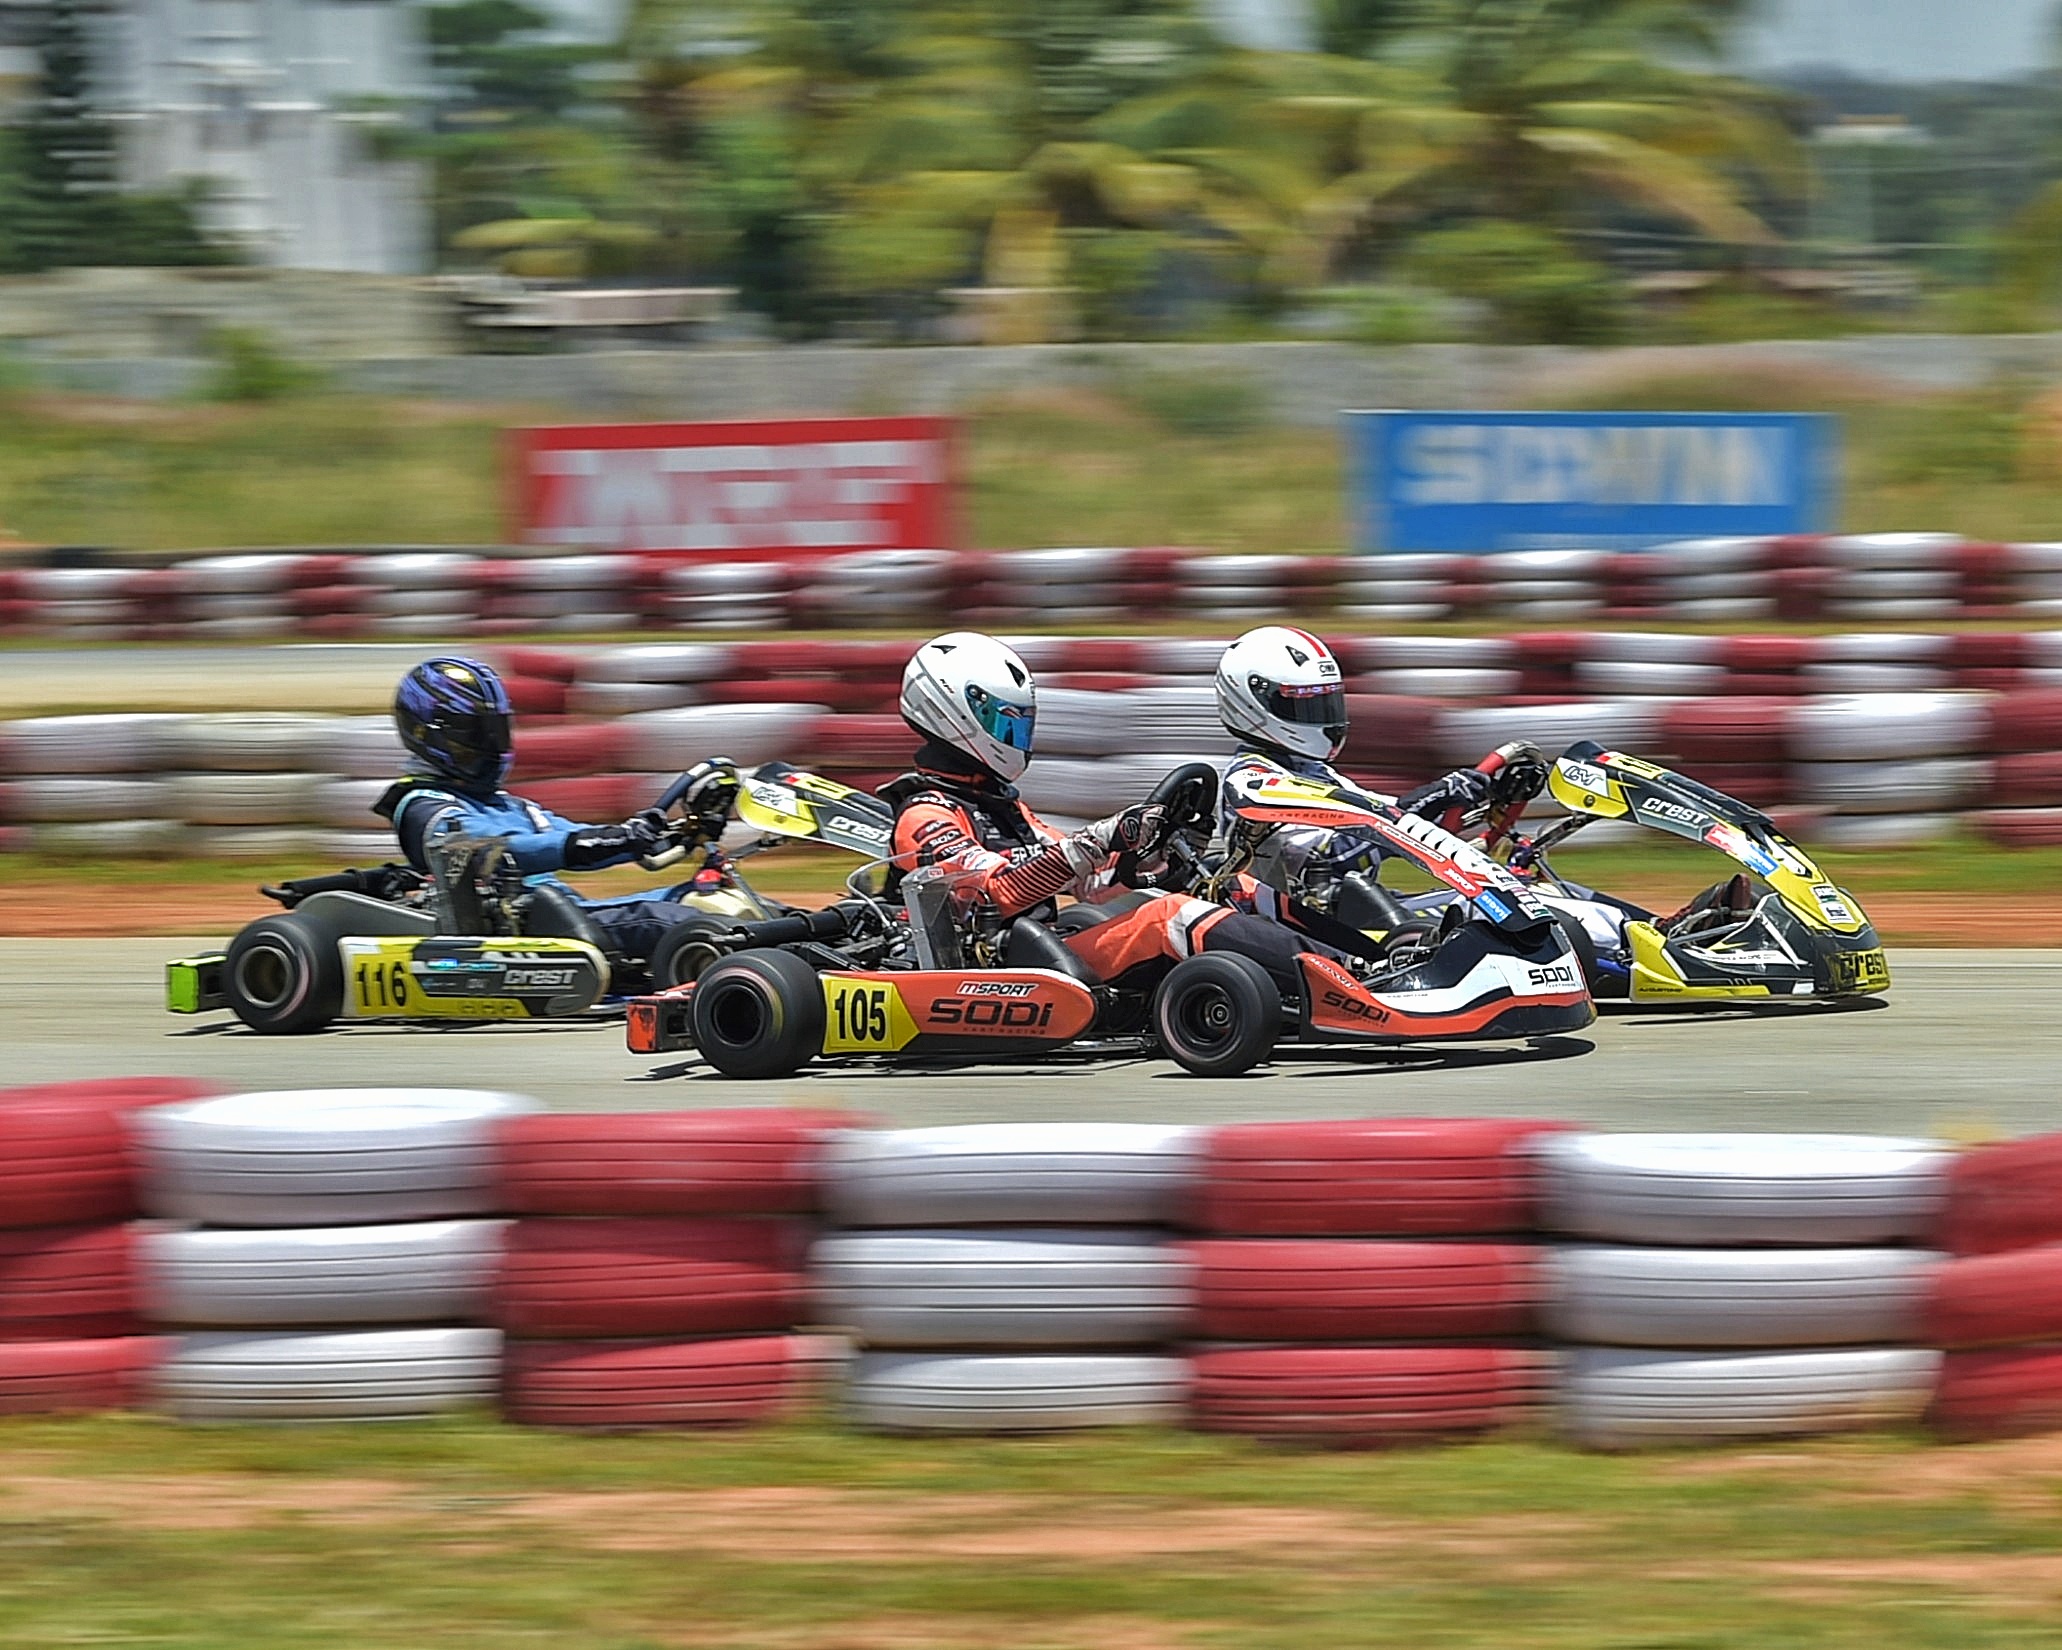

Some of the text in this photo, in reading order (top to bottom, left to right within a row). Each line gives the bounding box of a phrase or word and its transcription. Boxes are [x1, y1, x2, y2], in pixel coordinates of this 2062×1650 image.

[357, 965, 406, 1007] 116
[1528, 966, 1574, 986] SODI
[834, 988, 886, 1042] 105
[928, 998, 1054, 1027] SODI
[1323, 991, 1391, 1024] SODI
